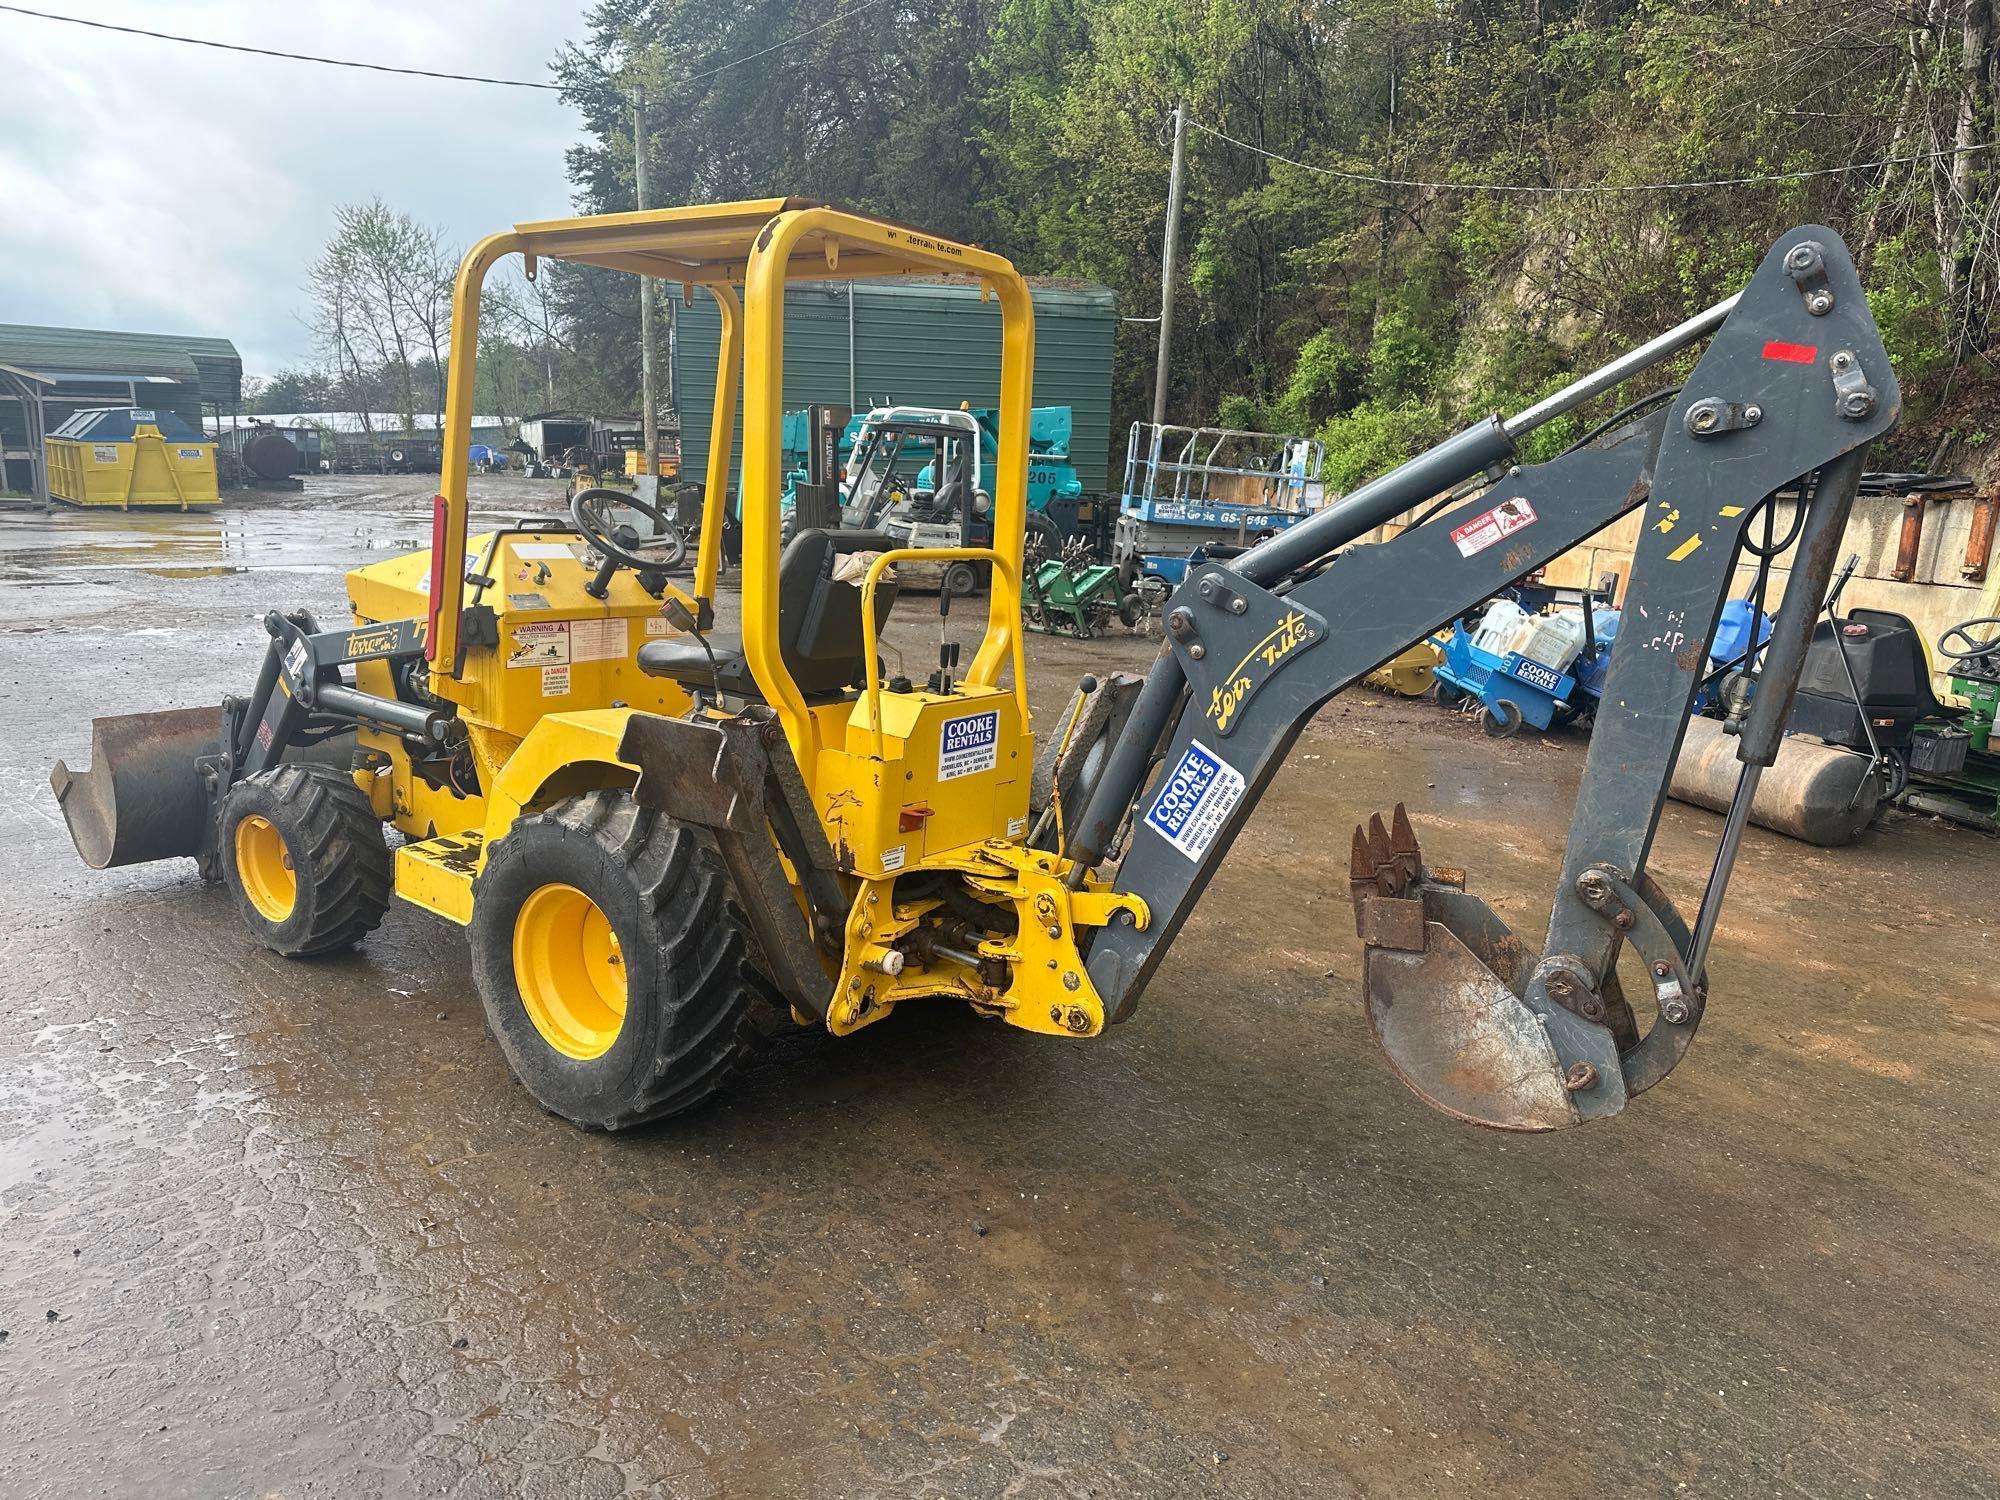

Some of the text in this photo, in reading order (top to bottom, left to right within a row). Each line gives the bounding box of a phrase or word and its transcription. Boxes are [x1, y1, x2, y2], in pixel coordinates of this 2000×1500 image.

[1220, 512, 1269, 526] GS-646
[1464, 515, 1492, 534] DANGER
[519, 625, 554, 633] WARNING
[551, 667, 568, 675] DANGER
[1517, 669, 1554, 690] RENTALS
[1521, 662, 1559, 684] COOKE
[948, 716, 993, 738] COOKE
[947, 730, 992, 750] RENTALS
[1156, 753, 1204, 822] COOKE
[1167, 763, 1214, 832] RENTALS
[1214, 786, 1232, 808] DENVER,
[1181, 772, 1228, 843] WWW.COOKERENTALS.COM
[1197, 833, 1210, 850] KING,
[1223, 797, 1235, 812] AIRY,
